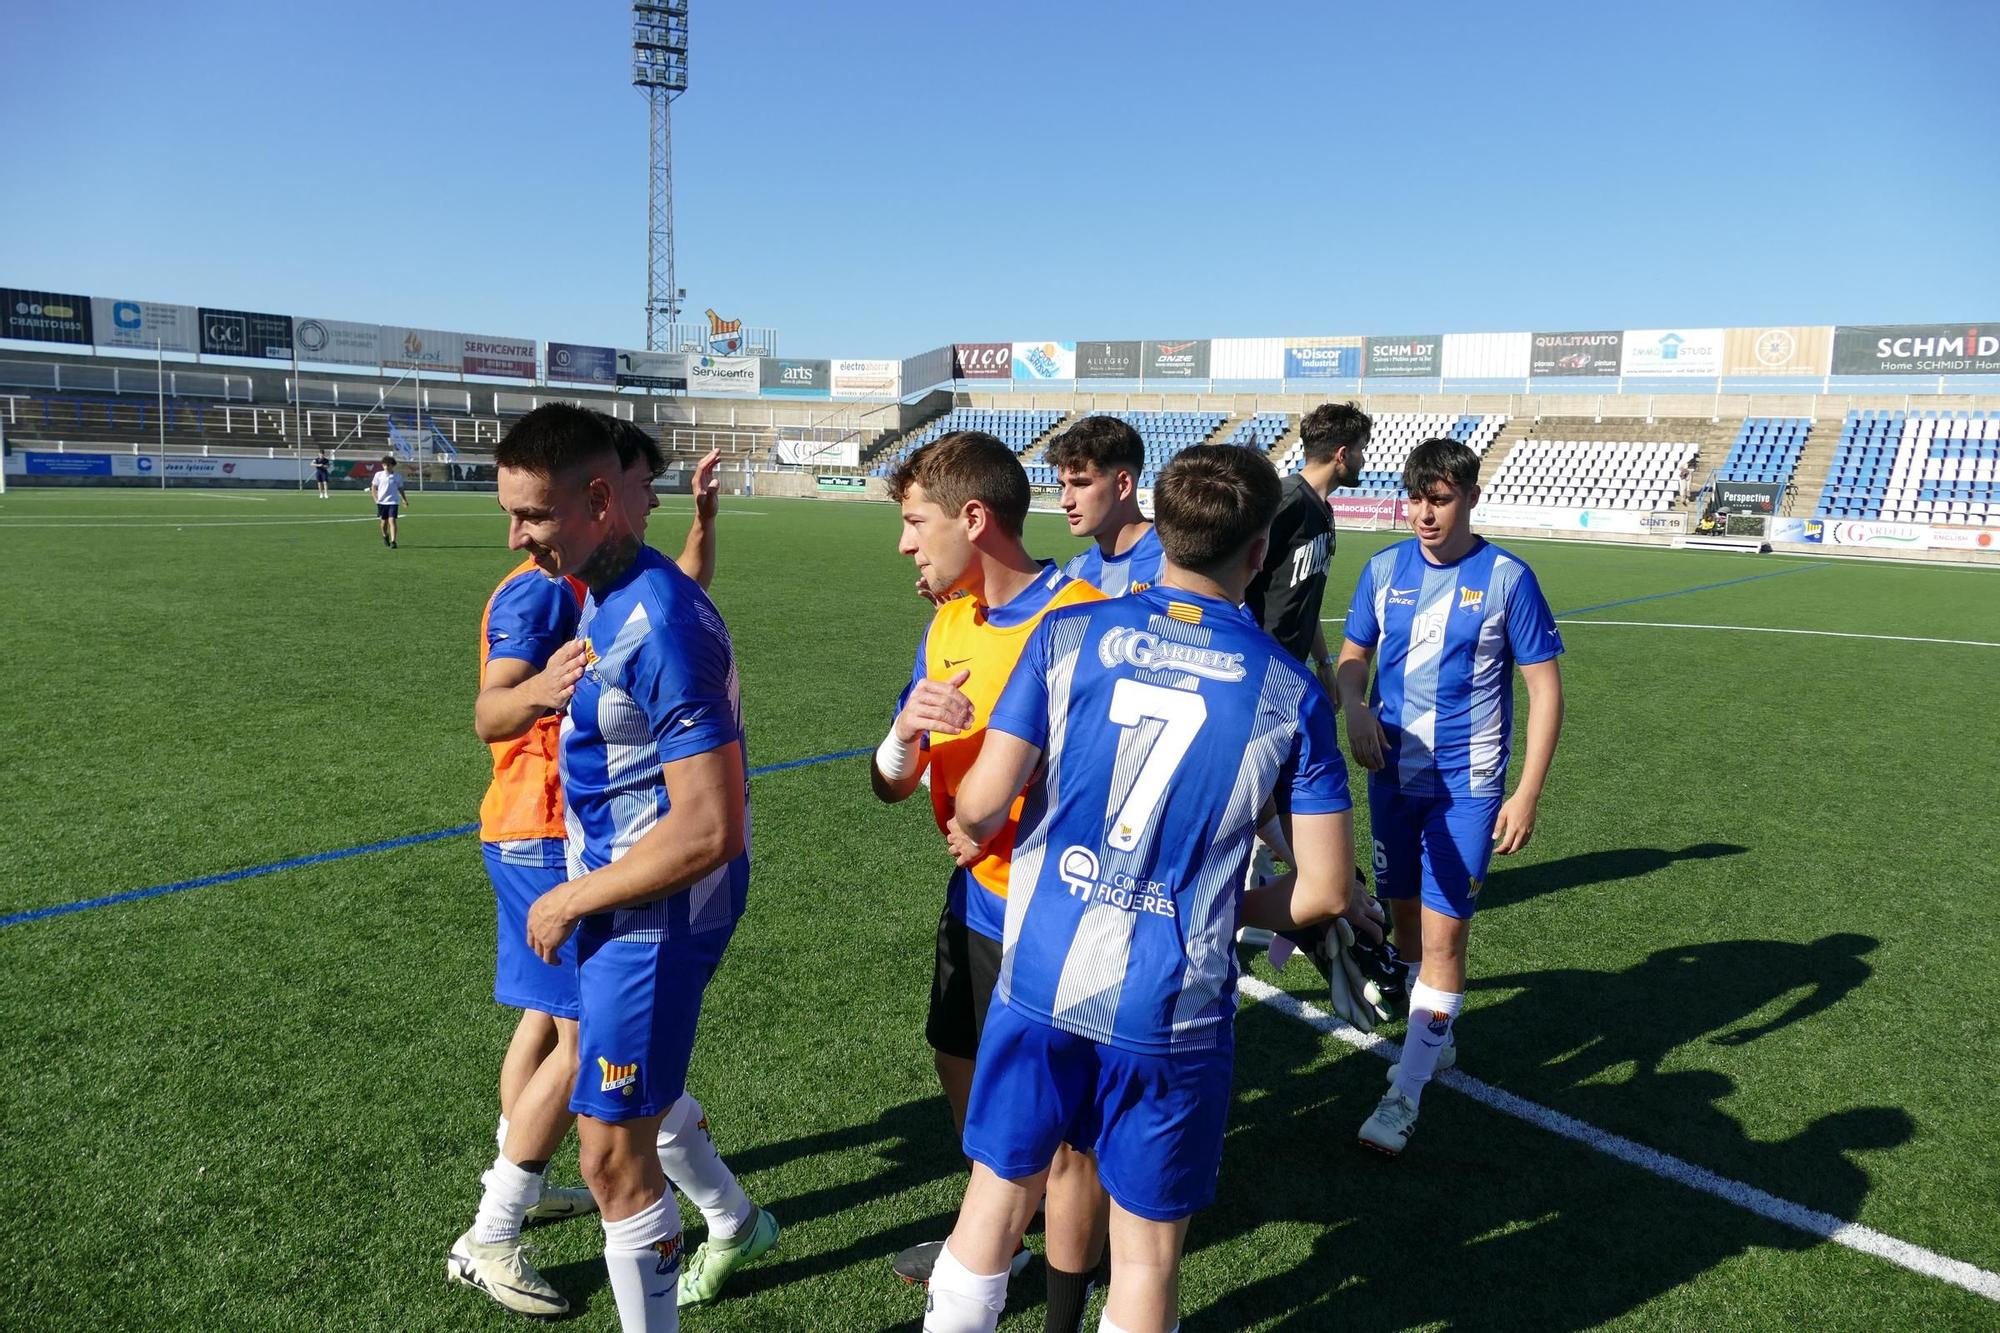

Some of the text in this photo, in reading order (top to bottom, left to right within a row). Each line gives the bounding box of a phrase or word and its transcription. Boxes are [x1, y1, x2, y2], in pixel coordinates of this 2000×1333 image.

[210, 324, 241, 343] GC
[1535, 336, 1618, 347] QUALITAUTO
[464, 341, 534, 357] SERVICENTRE
[1302, 349, 1341, 359] Discor
[1680, 347, 1713, 356] STUDI
[956, 348, 1009, 365] NICO
[1087, 357, 1129, 365] ALLEGRO
[1302, 359, 1338, 367] industrial
[1881, 361, 1912, 370] Home
[1917, 360, 1972, 370] SCHMIDT
[692, 366, 754, 379] Servicentre
[784, 366, 812, 380] arts
[1724, 491, 1770, 503] Perspective
[1640, 517, 1680, 527] CENT 19
[1389, 597, 1416, 606] ONZE
[1416, 613, 1444, 644] 16
[1109, 678, 1208, 853] 7
[1114, 873, 1167, 896] COMERÇ
[1098, 883, 1177, 919] FIGUERES
